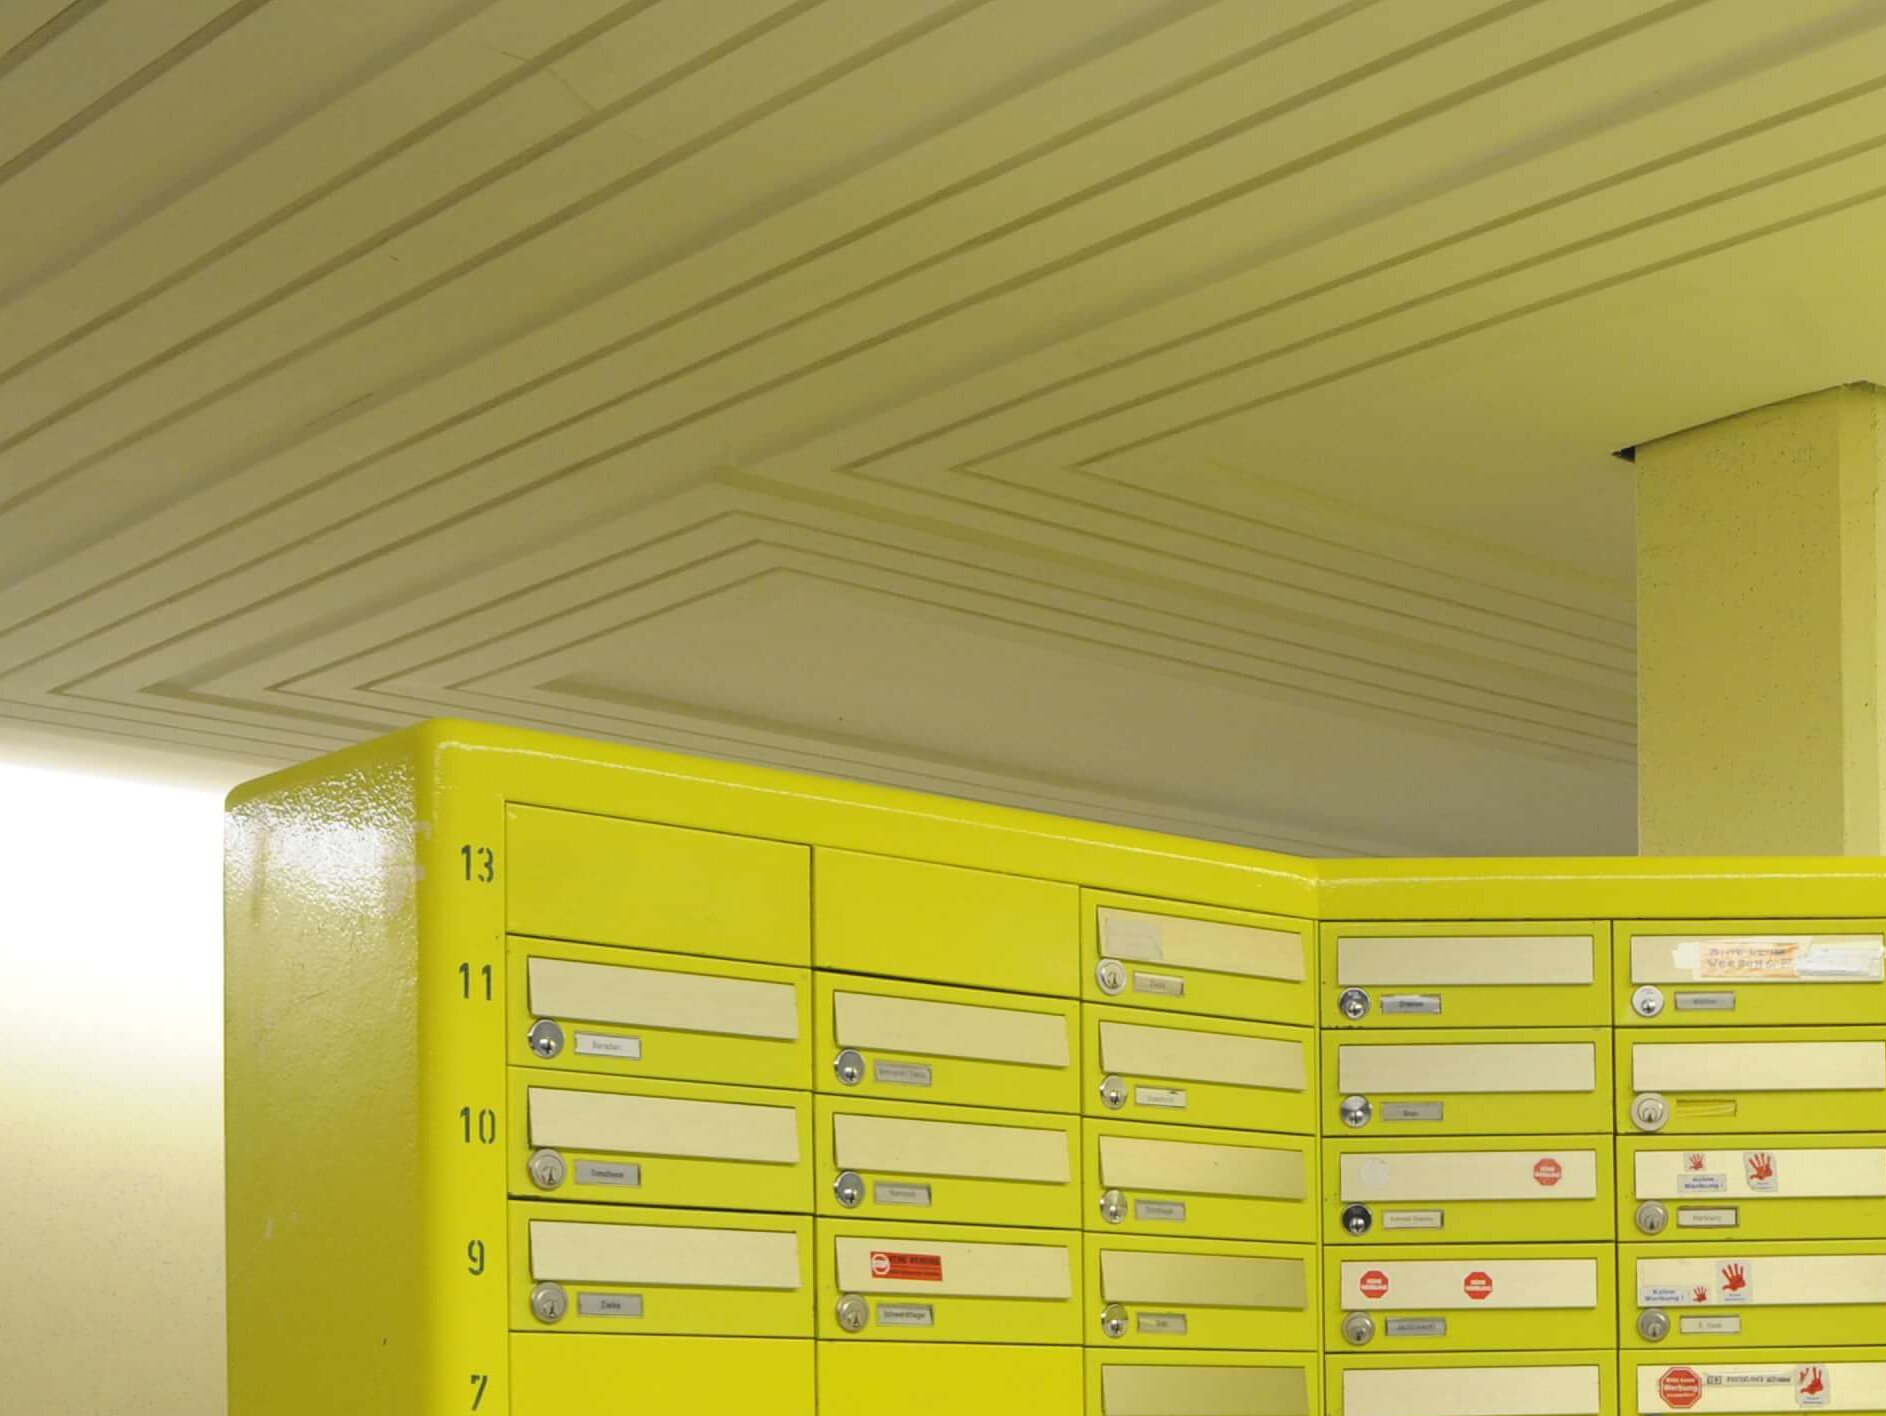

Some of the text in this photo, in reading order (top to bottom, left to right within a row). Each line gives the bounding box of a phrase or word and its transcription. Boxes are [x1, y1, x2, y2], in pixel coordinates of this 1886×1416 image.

[461, 844, 495, 883] 13
[459, 962, 492, 1001] 11
[460, 1106, 496, 1145] 10
[468, 1239, 485, 1276] 9
[470, 1374, 488, 1412] 7
